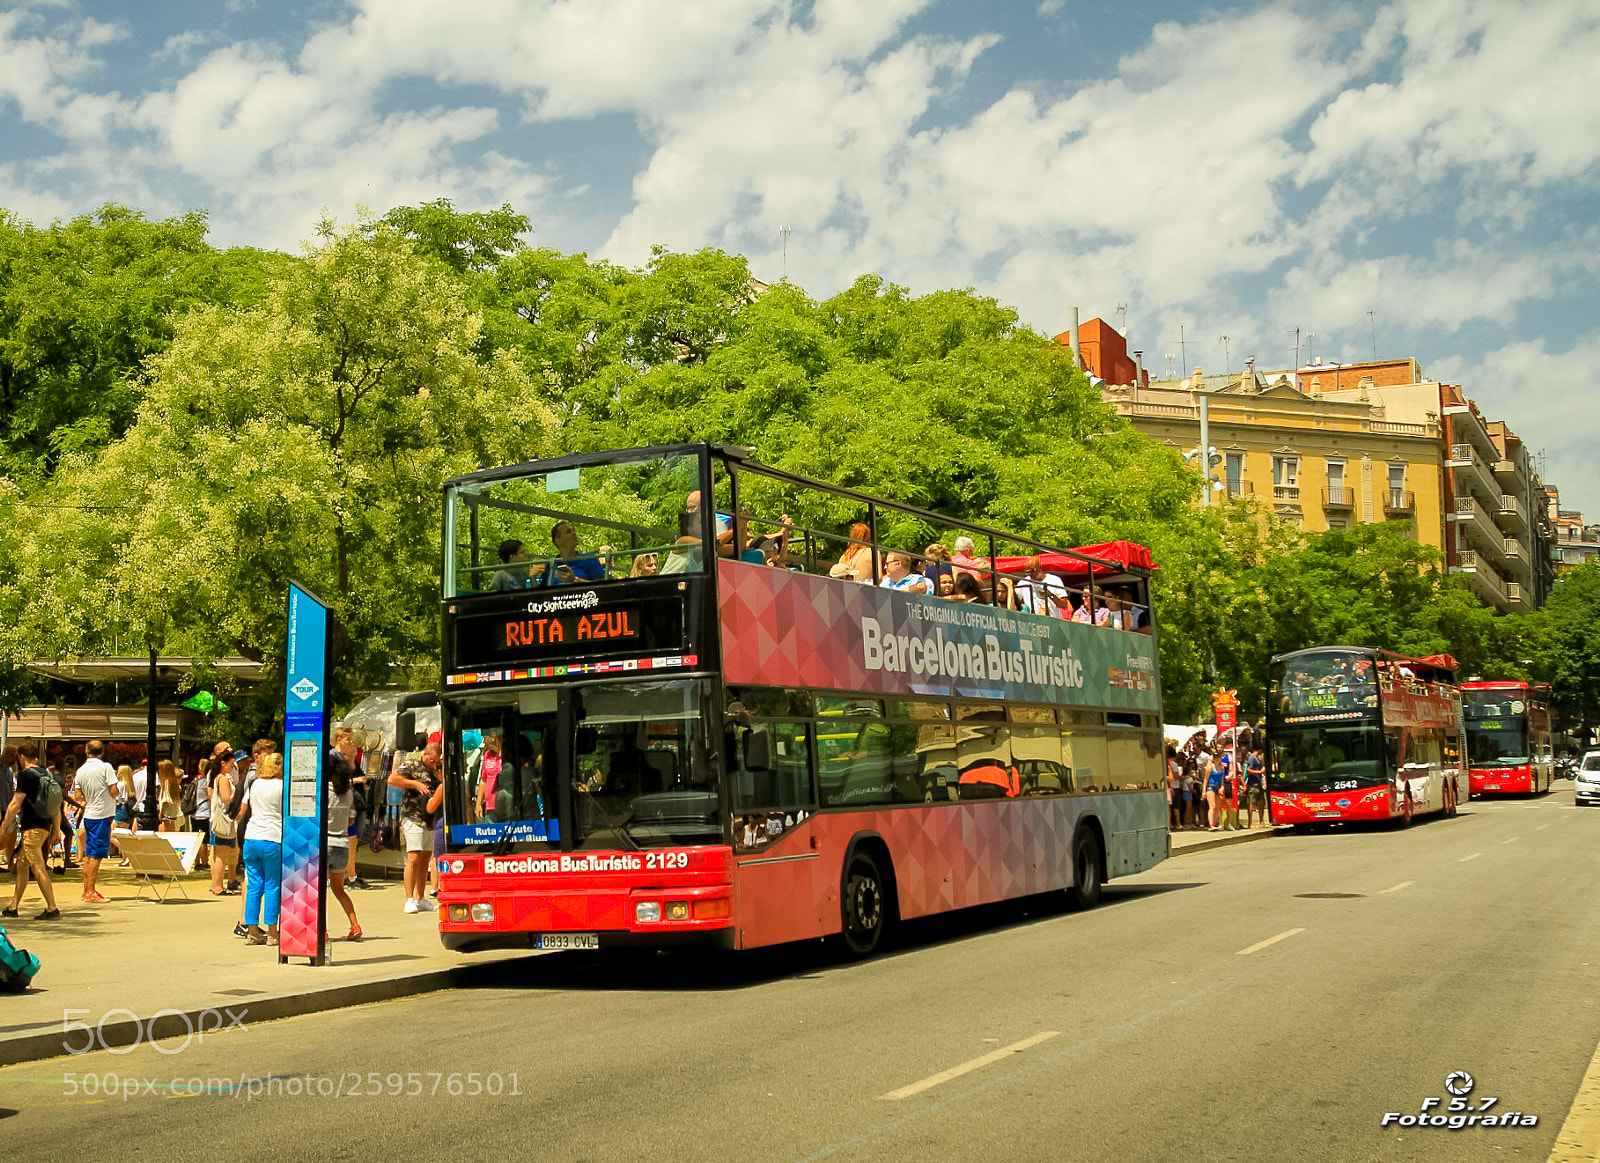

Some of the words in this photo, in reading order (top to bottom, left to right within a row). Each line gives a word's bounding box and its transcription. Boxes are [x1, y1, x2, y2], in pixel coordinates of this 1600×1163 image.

[905, 602, 922, 620] THE
[923, 604, 960, 626] ORIGINAL
[961, 614, 966, 626] &
[966, 612, 998, 631] OFFICIAL
[998, 618, 1017, 634] TOUR
[1018, 621, 1036, 637] SINCE
[506, 619, 563, 646] RUTA
[577, 612, 634, 639] AZUL
[861, 616, 987, 680] Barcelona
[985, 634, 1084, 689] BusTurístic
[1306, 699, 1338, 707] VERDE
[1334, 780, 1358, 790] 2542
[475, 827, 497, 836] Ruta
[484, 856, 559, 874] Barcelona
[560, 854, 641, 872] BusTurístic
[645, 853, 688, 869] 2129
[543, 935, 569, 947] 0833
[574, 935, 593, 948] CVL
